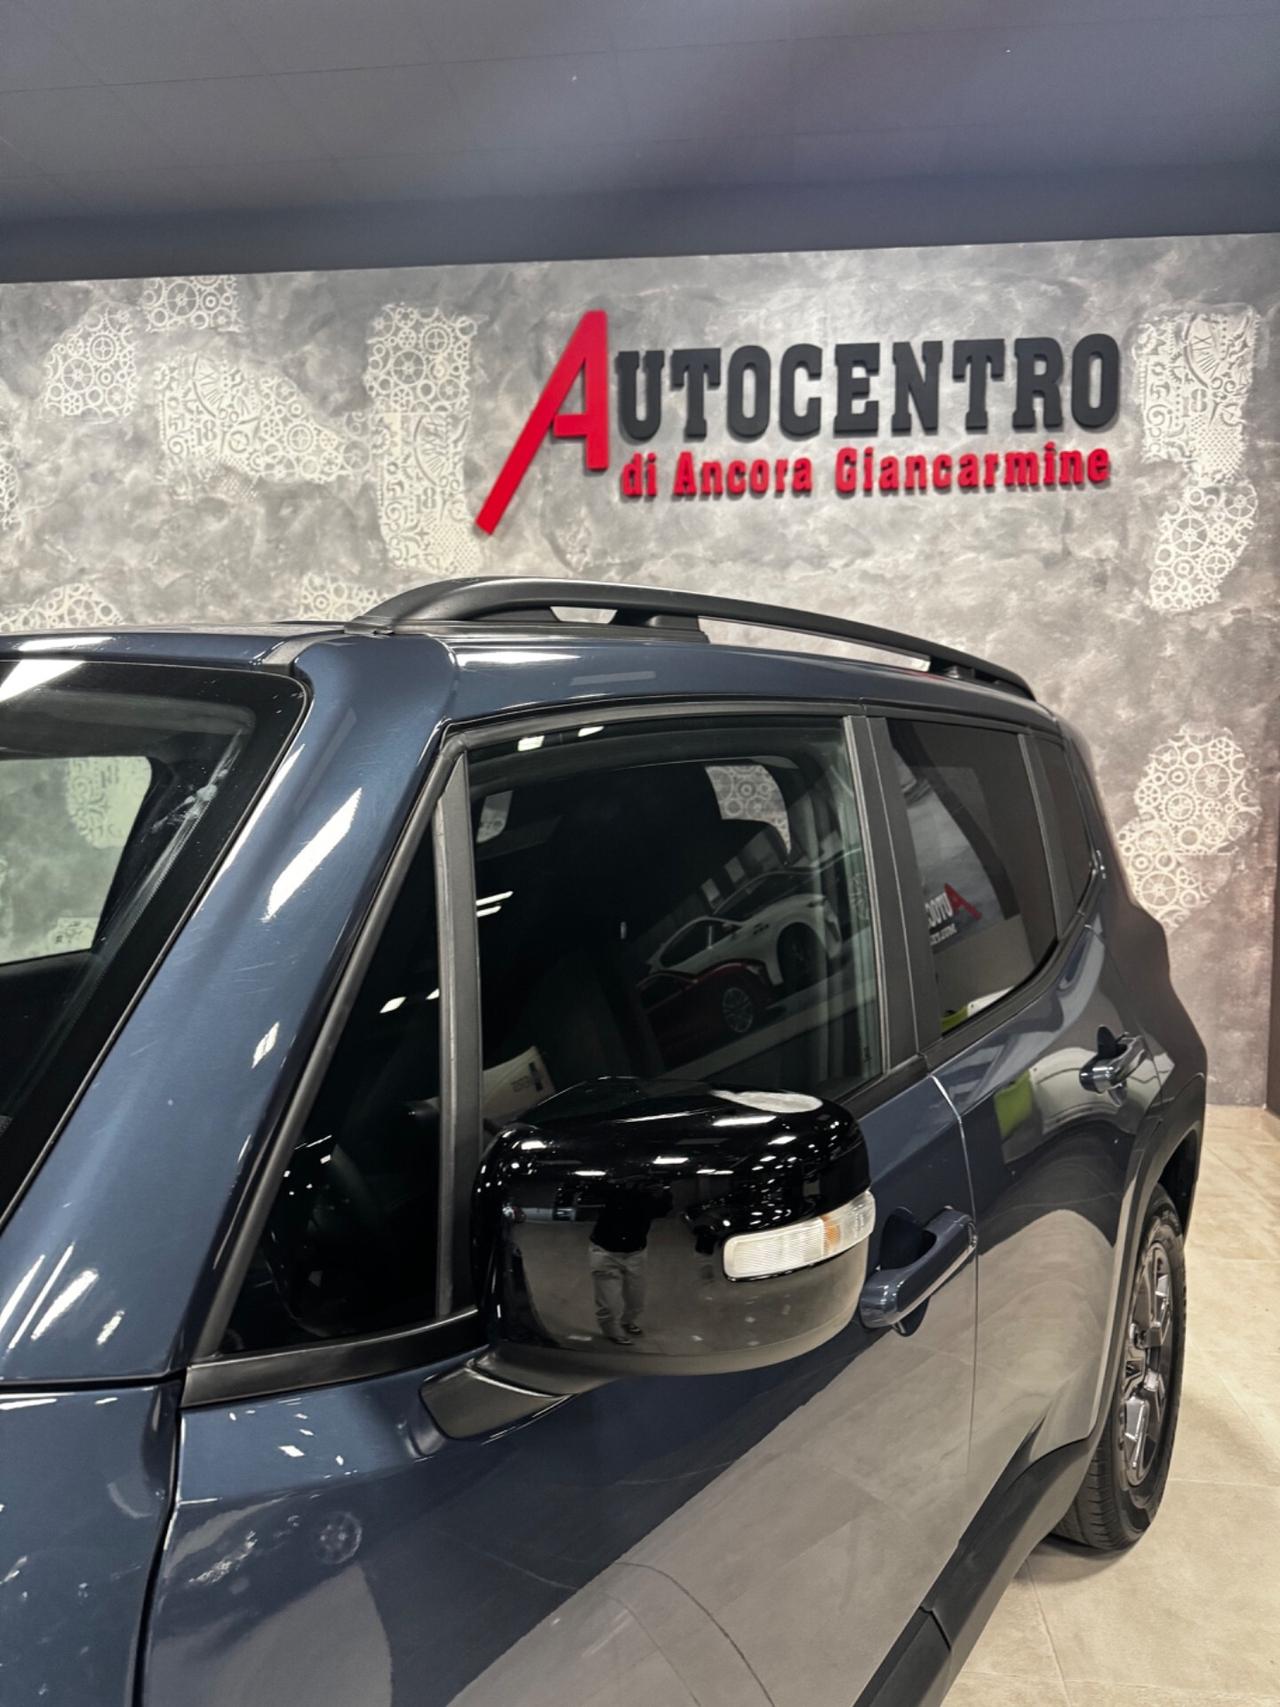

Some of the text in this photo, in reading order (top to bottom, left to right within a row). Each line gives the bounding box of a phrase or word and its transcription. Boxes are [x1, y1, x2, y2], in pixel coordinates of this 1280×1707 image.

[475, 310, 1120, 537] AUTOCENTRO
[621, 441, 1111, 497] di Ancora Giancarmine
